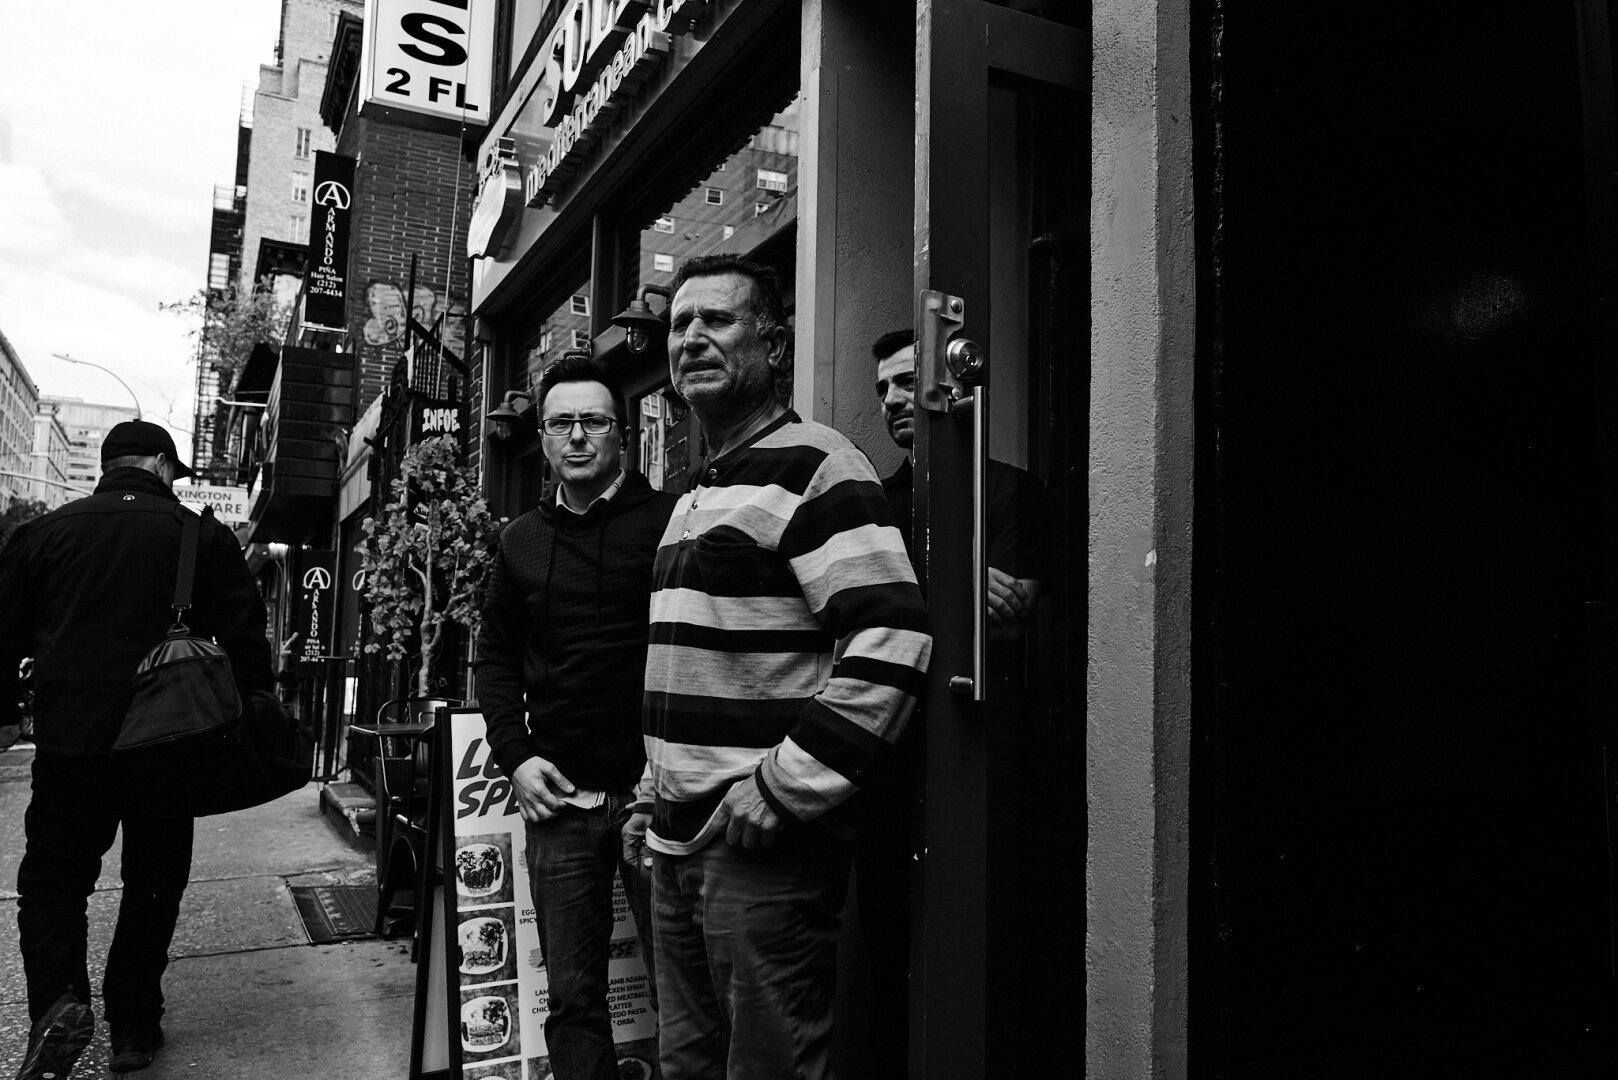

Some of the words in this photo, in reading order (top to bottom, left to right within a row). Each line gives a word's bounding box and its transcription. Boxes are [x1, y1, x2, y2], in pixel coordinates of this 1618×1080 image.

[384, 67, 411, 97] 2
[428, 76, 479, 112] FL
[323, 207, 336, 266] ARMANDO
[310, 271, 325, 279] Hair
[325, 274, 344, 283] Salon
[316, 280, 337, 290] (212)
[309, 286, 343, 298] 207-4434
[204, 502, 243, 514] ARE
[625, 974, 648, 983] ADANA
[626, 983, 646, 992] SHISH
[616, 991, 649, 1001] MEATBALL
[627, 1007, 648, 1016] PASTA
[616, 1017, 636, 1026] OKRA
